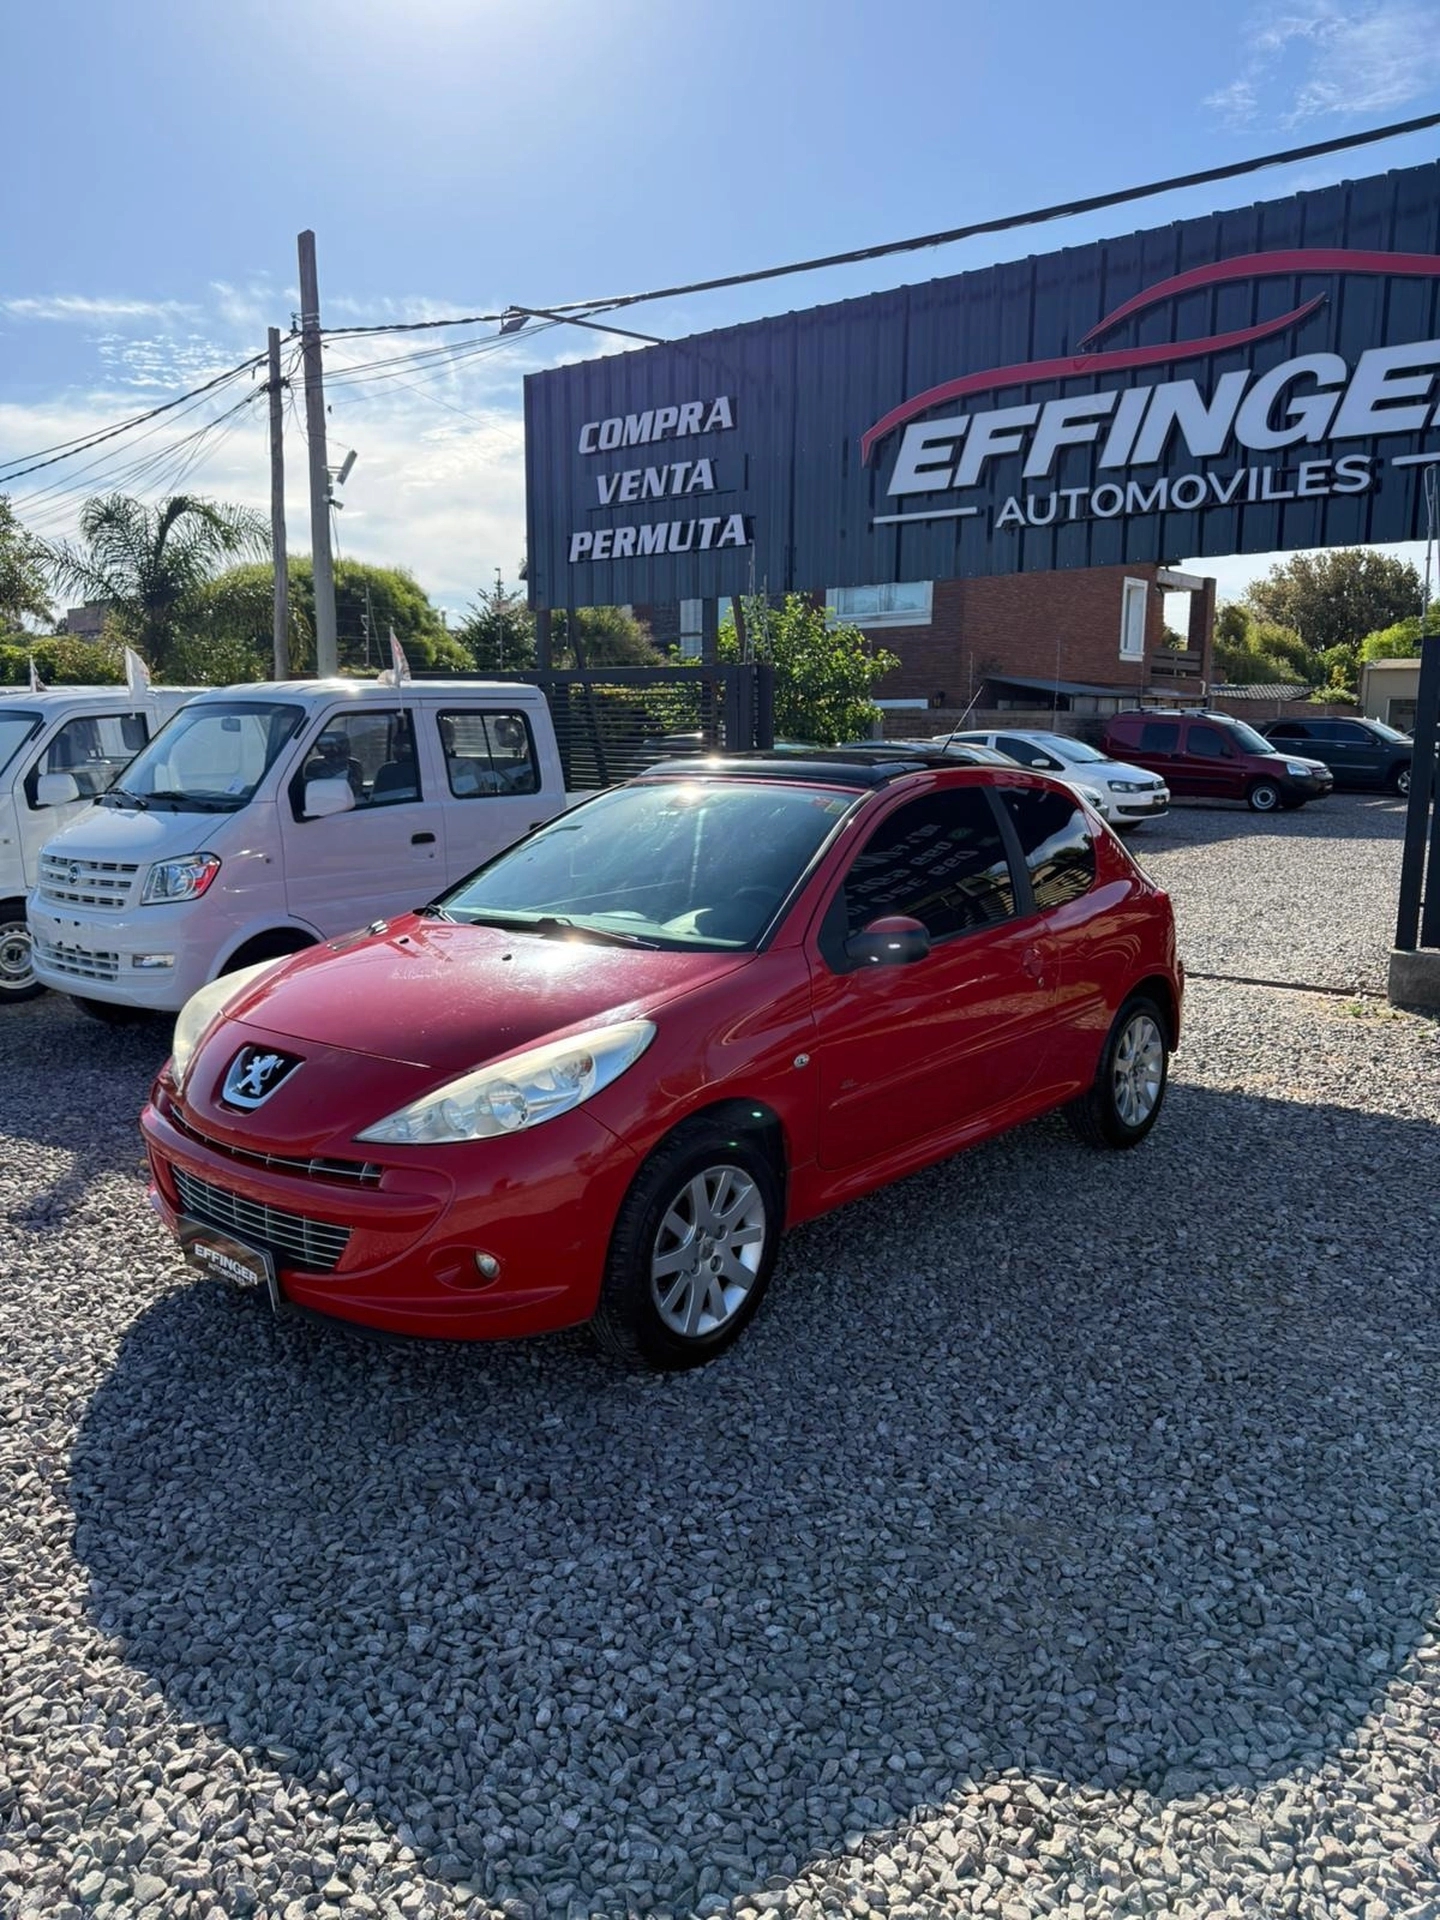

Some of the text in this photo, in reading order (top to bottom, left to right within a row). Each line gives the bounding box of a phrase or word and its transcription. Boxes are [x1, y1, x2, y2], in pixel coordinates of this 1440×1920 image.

[577, 395, 734, 454] COMPRA
[886, 339, 1440, 497] EFFINGE
[596, 457, 715, 505] VENTA
[994, 454, 1373, 529] AUTOMOVILES
[568, 513, 747, 563] PERMUTA
[194, 1243, 258, 1286] EFFINGER
